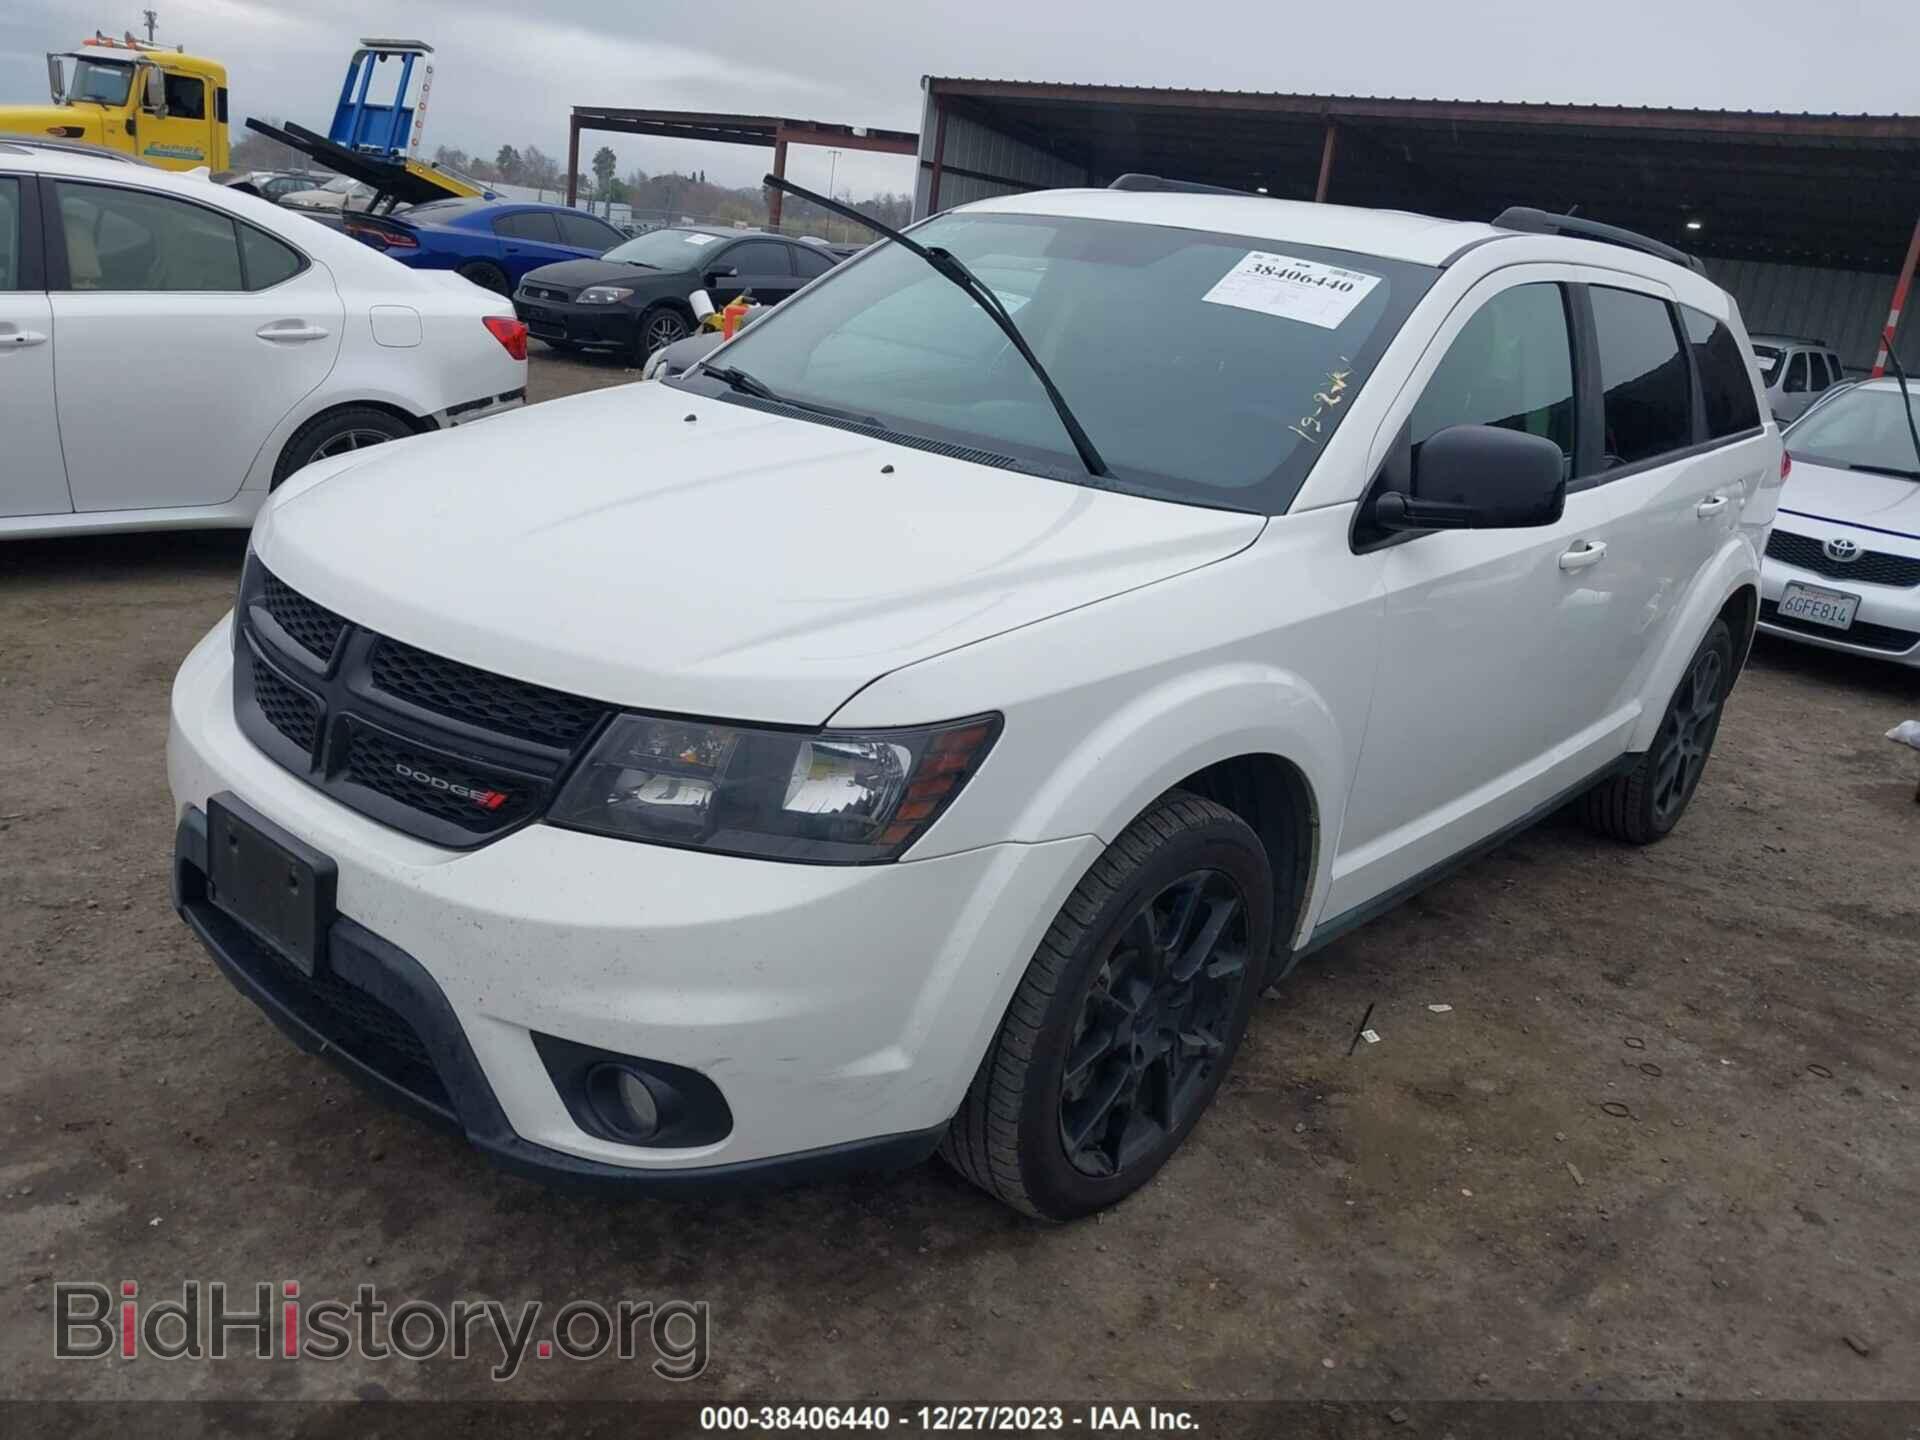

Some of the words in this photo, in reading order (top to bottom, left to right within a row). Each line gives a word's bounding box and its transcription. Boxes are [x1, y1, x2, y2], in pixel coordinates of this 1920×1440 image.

[1246, 262, 1355, 294] 38406440
[1784, 595, 1847, 623] 6GFE814
[395, 763, 490, 805] DODGE
